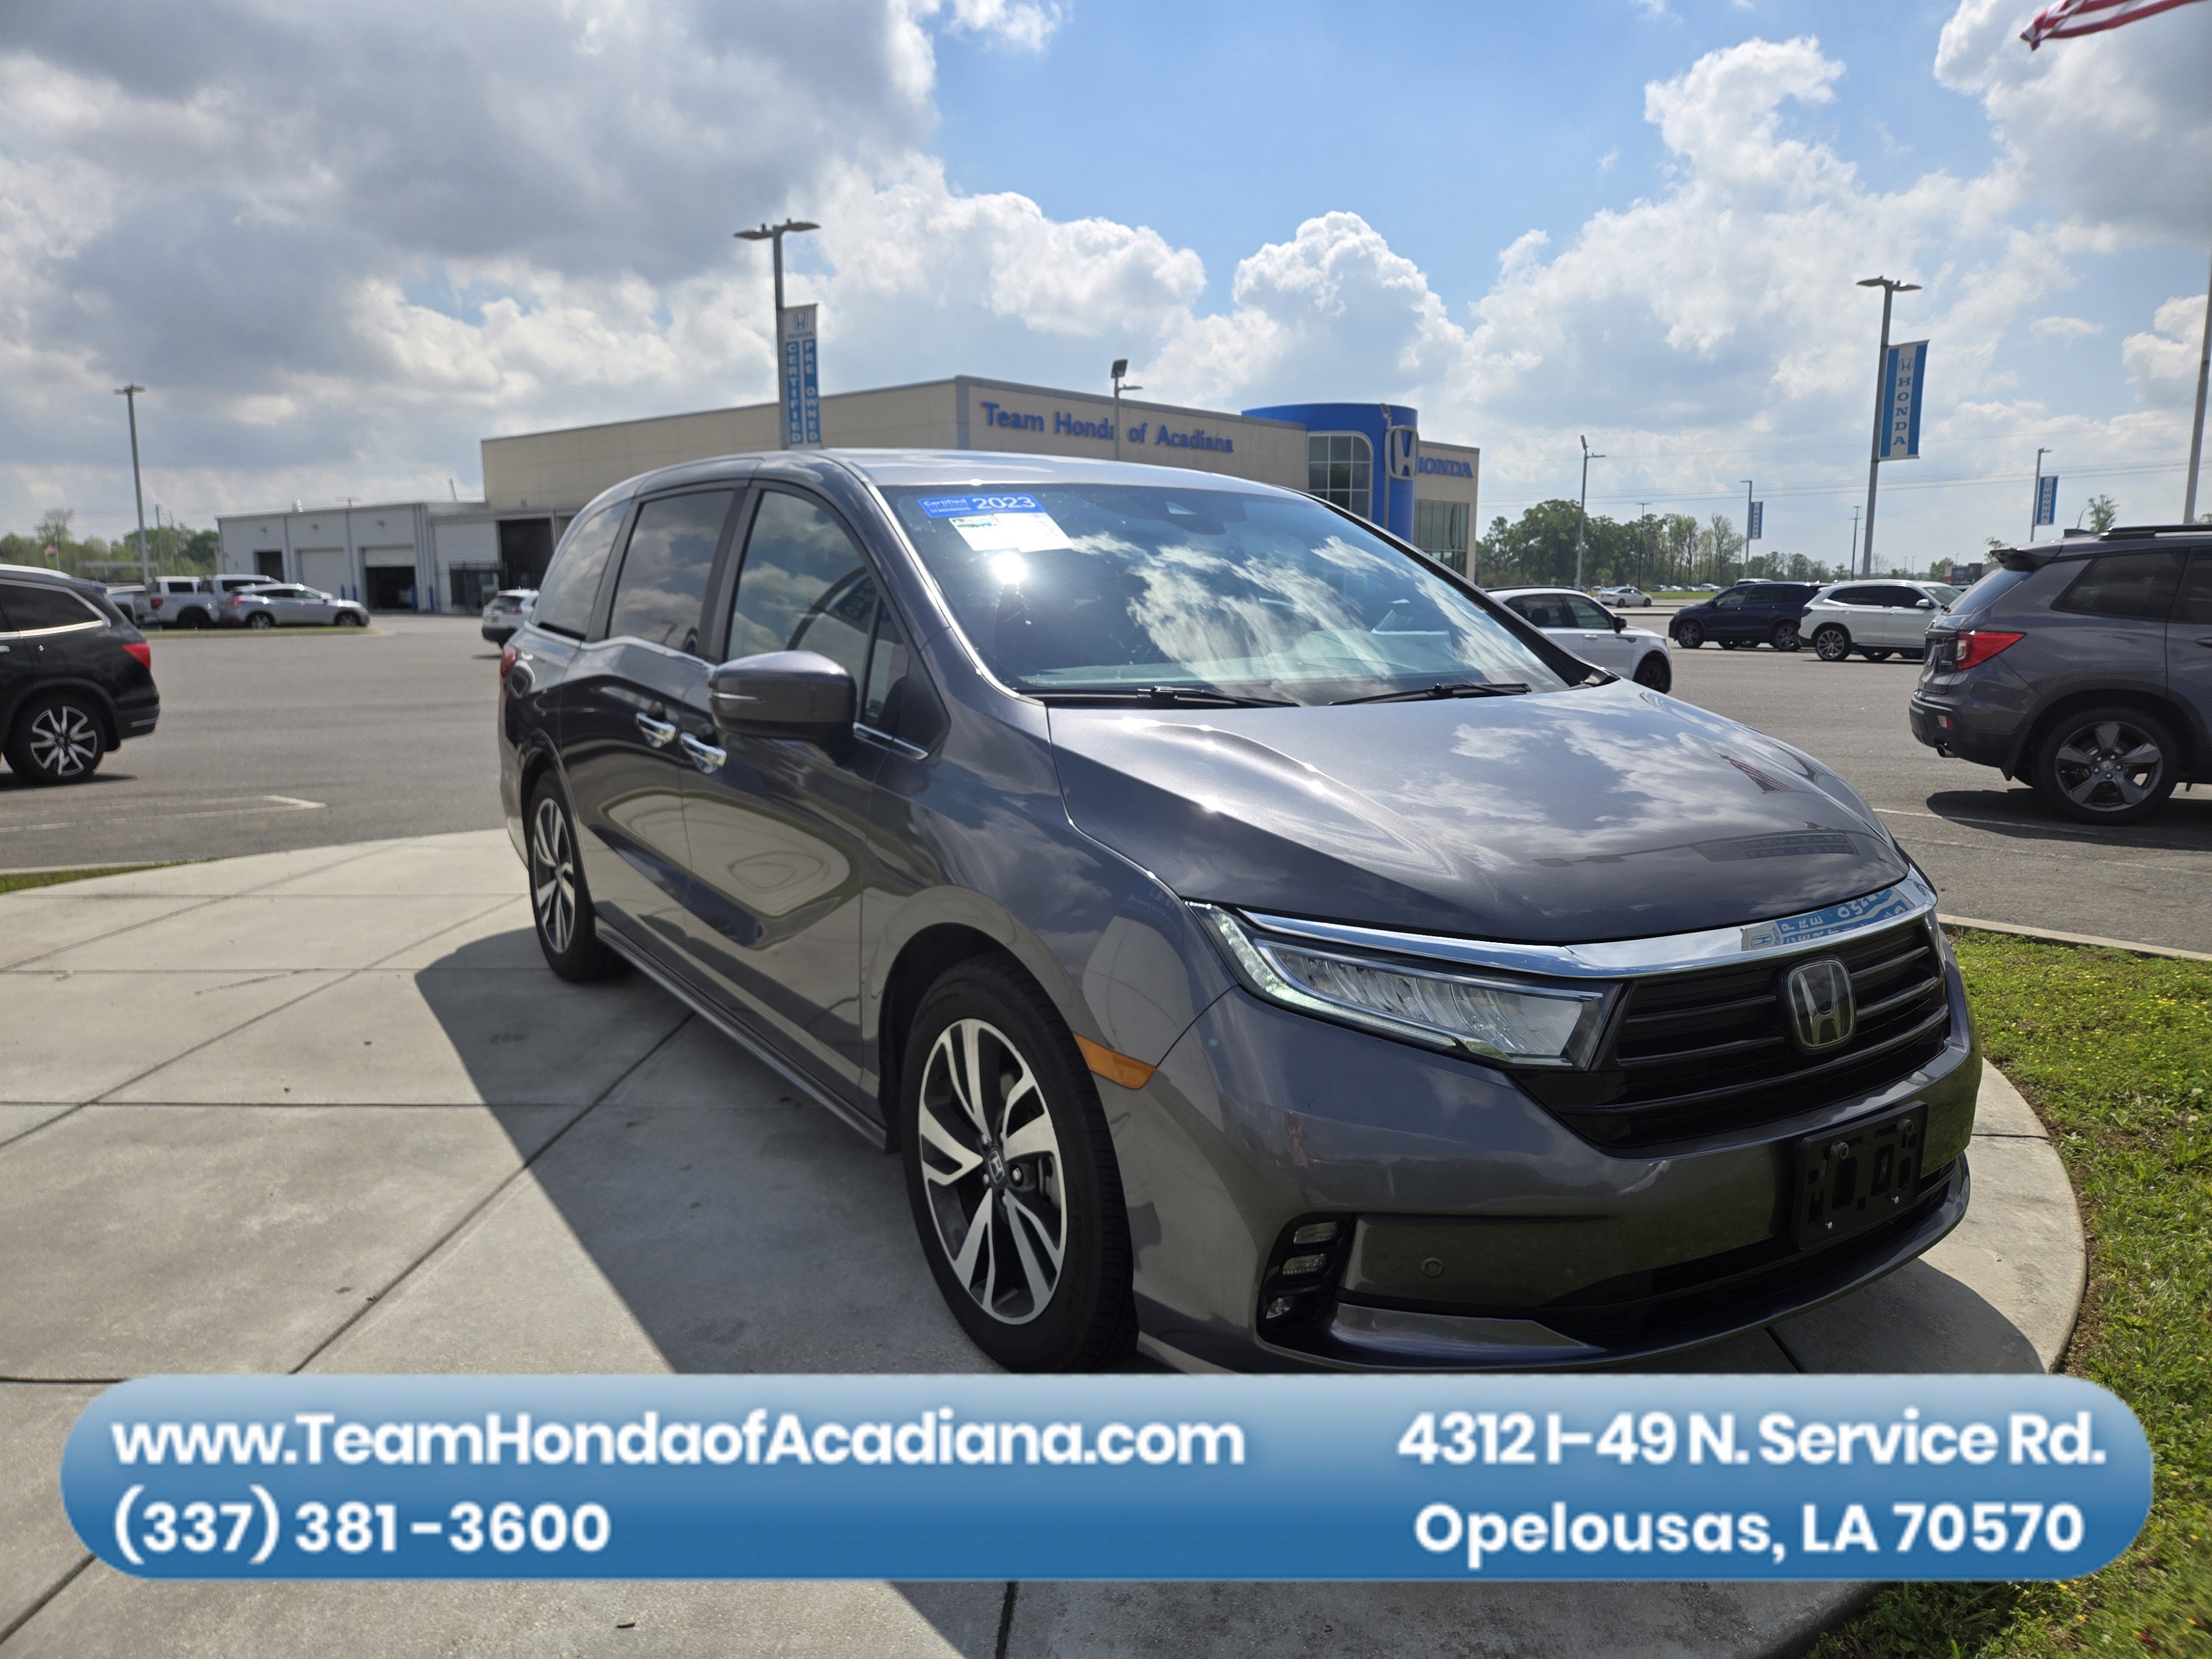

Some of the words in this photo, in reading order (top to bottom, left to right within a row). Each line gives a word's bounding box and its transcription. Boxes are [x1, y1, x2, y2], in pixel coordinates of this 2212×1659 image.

[805, 342, 815, 375] PRE
[787, 343, 802, 442] CERTIFIED
[806, 386, 818, 441] OWNED
[1892, 377, 1911, 446] HONDA
[982, 402, 1045, 431] Team
[1128, 422, 1149, 443] of
[1156, 425, 1234, 453] Acadiana
[923, 498, 967, 507] Certified
[972, 496, 1036, 510] 2023
